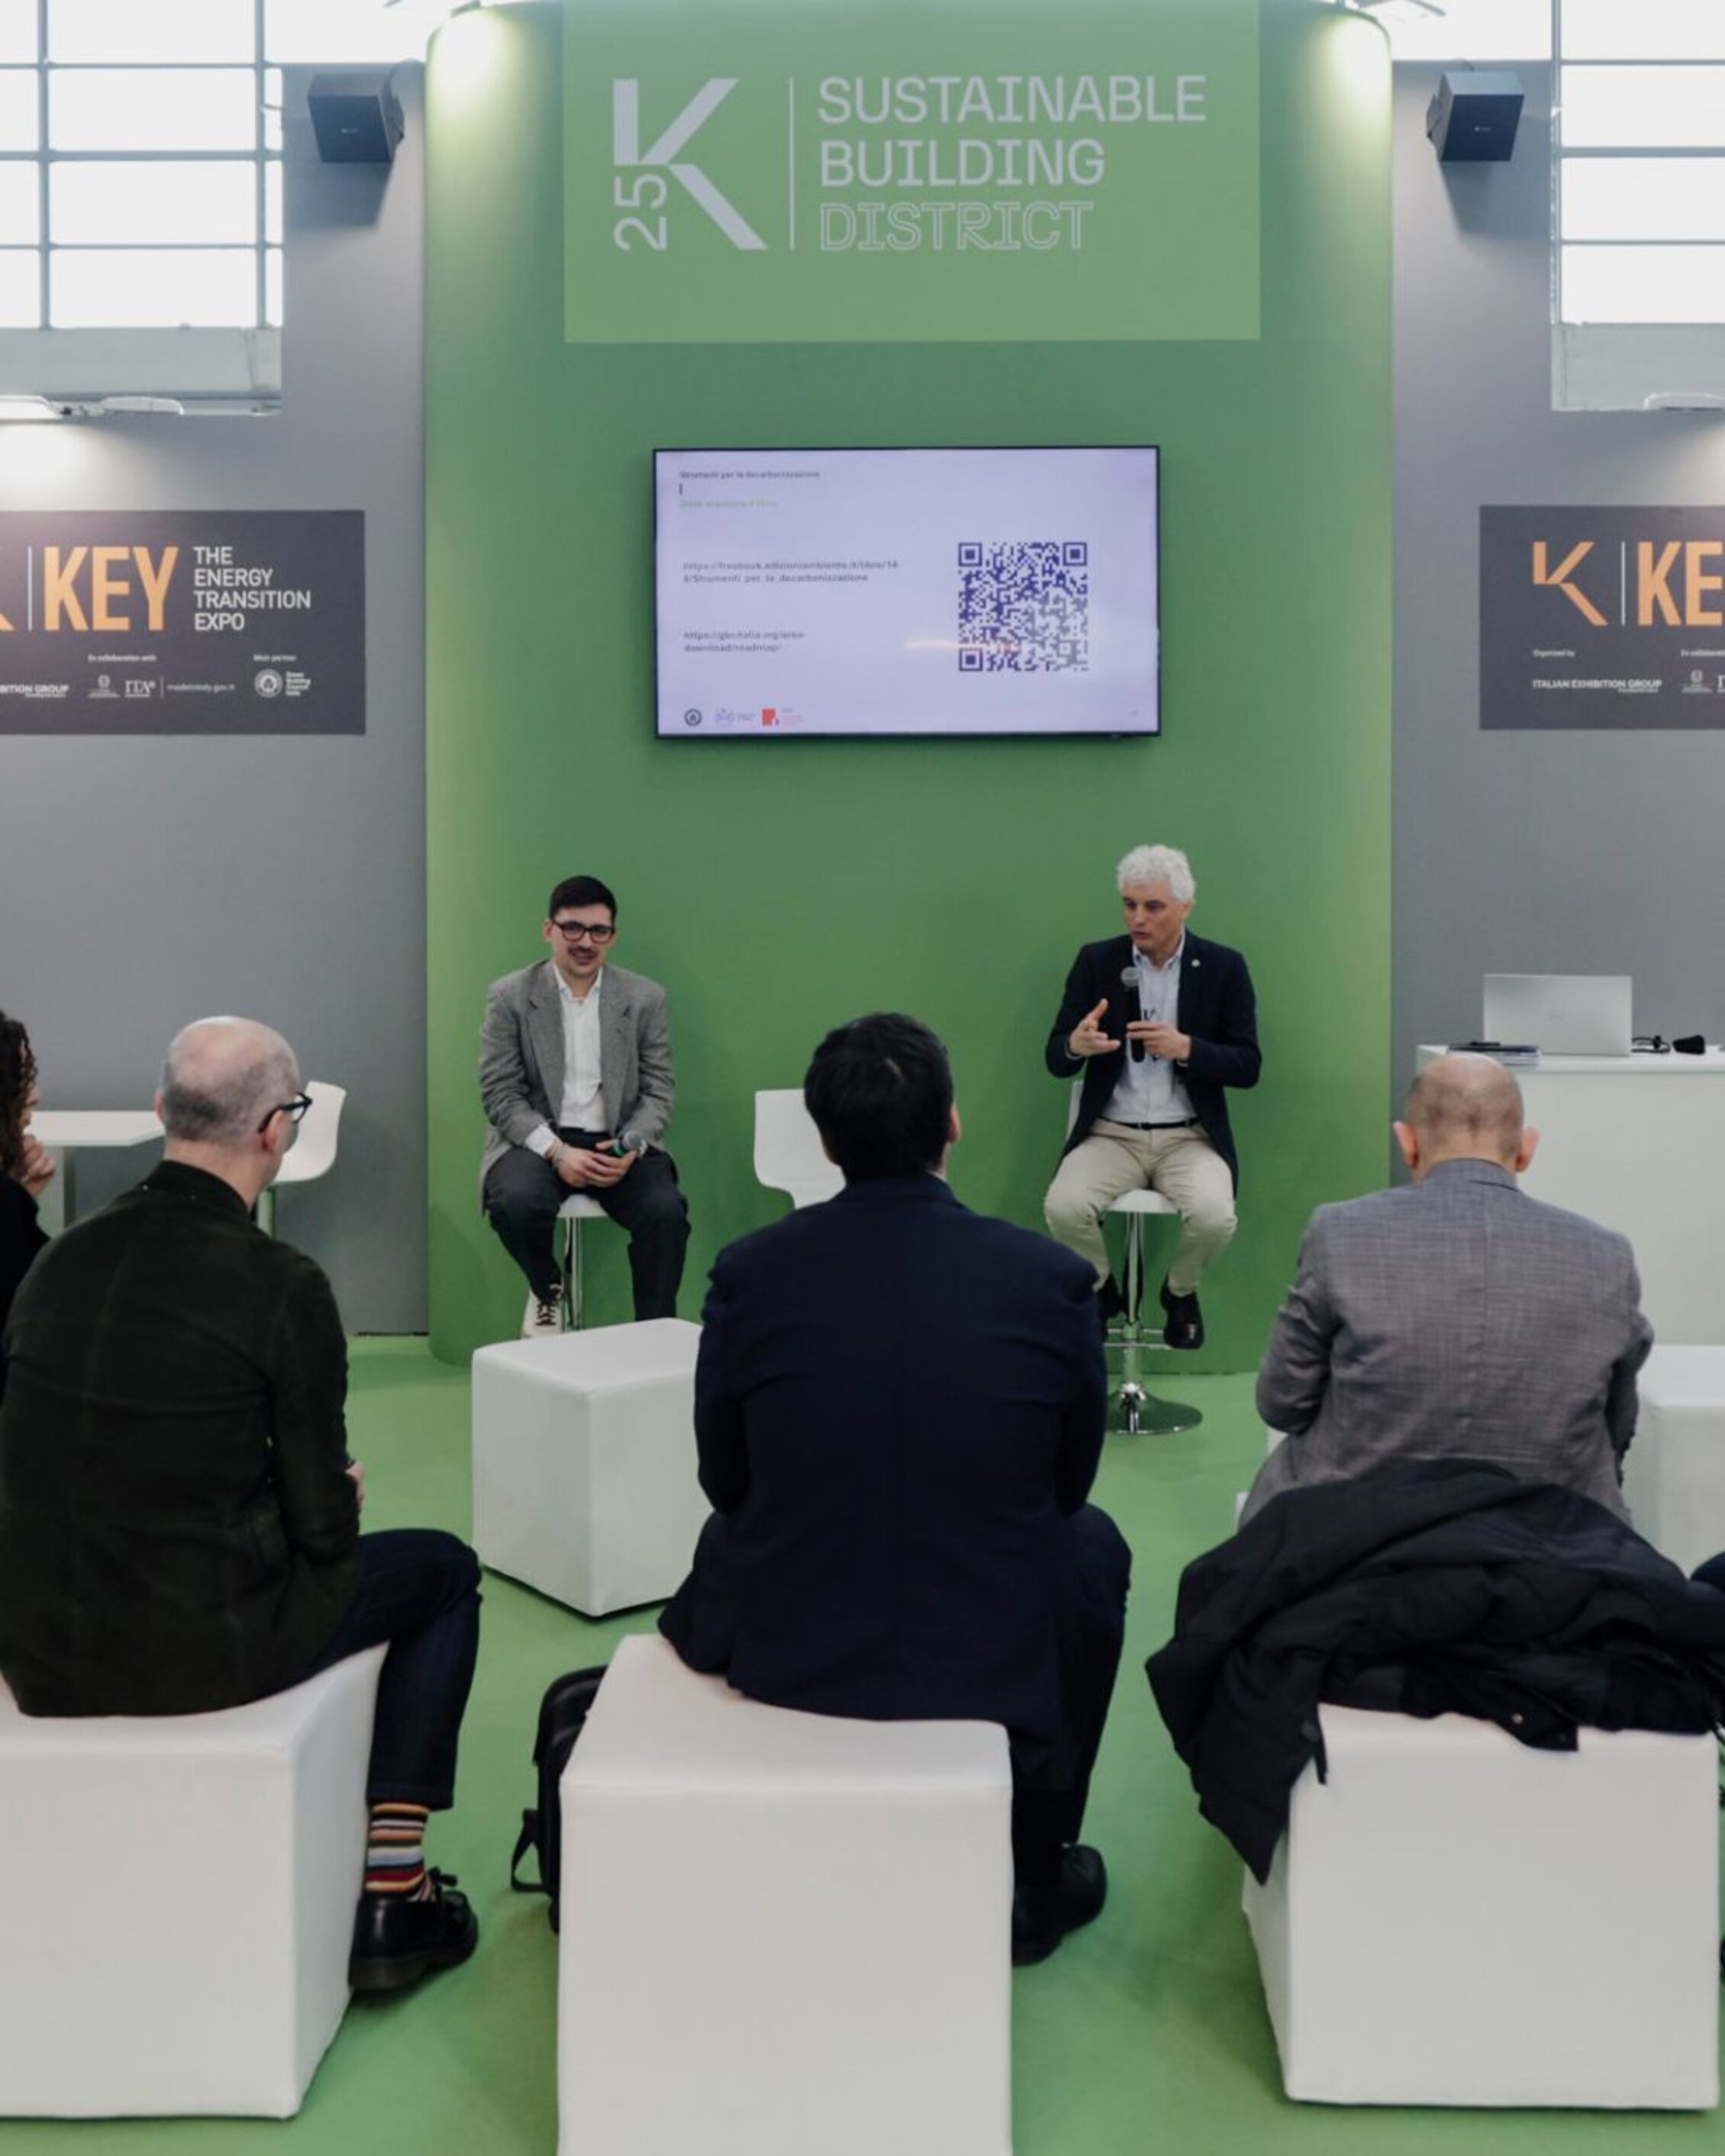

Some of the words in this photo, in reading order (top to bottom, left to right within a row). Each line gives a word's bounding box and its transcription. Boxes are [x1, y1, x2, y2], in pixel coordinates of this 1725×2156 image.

[817, 75, 1207, 124] SUSTAINABLE
[820, 138, 1106, 187] BUILDING
[820, 201, 1094, 251] DISTRICT
[193, 546, 234, 565] THE
[194, 569, 273, 587] ENERGY
[44, 546, 179, 632] KEY
[194, 591, 311, 609] TRANSITION
[194, 612, 245, 631] EXPO
[34, 685, 69, 694] GROUP
[1533, 680, 1570, 689] ITALIAN
[1572, 680, 1626, 689] EXHIBITION
[1627, 680, 1662, 689] GROUP
